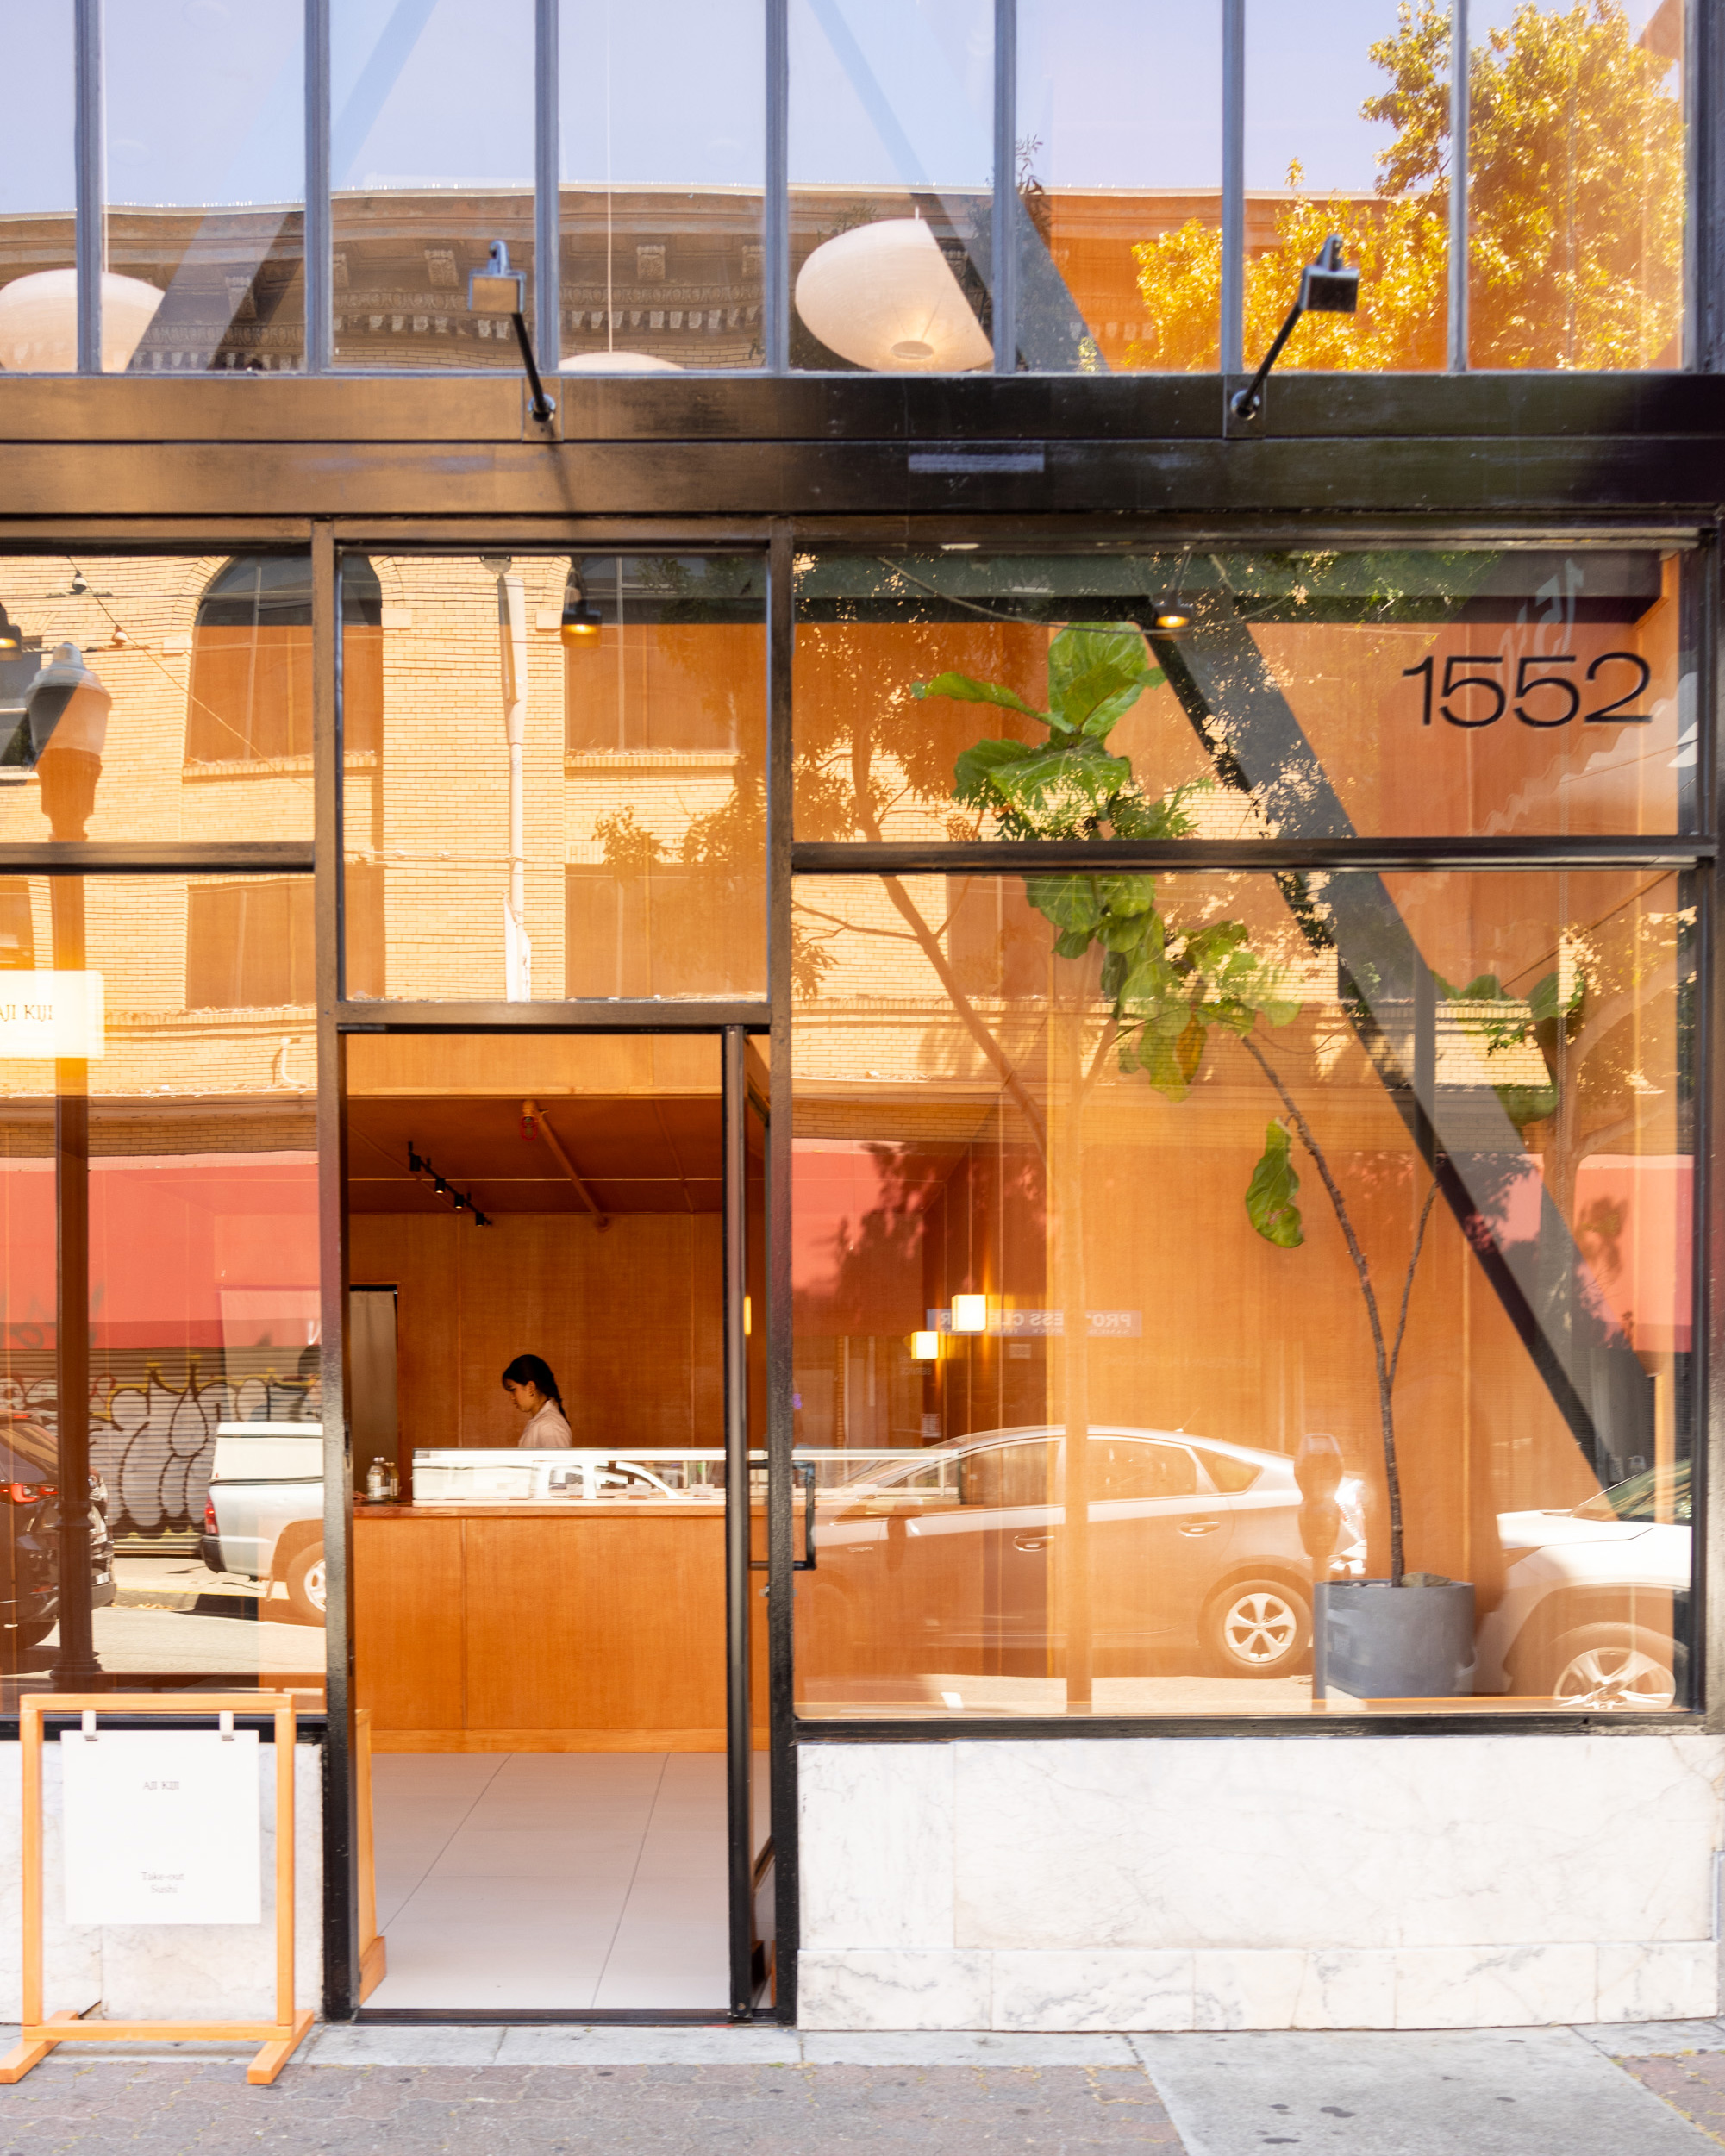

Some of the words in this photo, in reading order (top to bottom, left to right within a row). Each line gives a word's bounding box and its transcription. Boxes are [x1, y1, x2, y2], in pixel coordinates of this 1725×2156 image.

[1402, 652, 1653, 728] 1552
[24, 1005, 53, 1022] KIJI
[142, 1781, 157, 1790] AJI
[141, 1872, 185, 1880] Take-out
